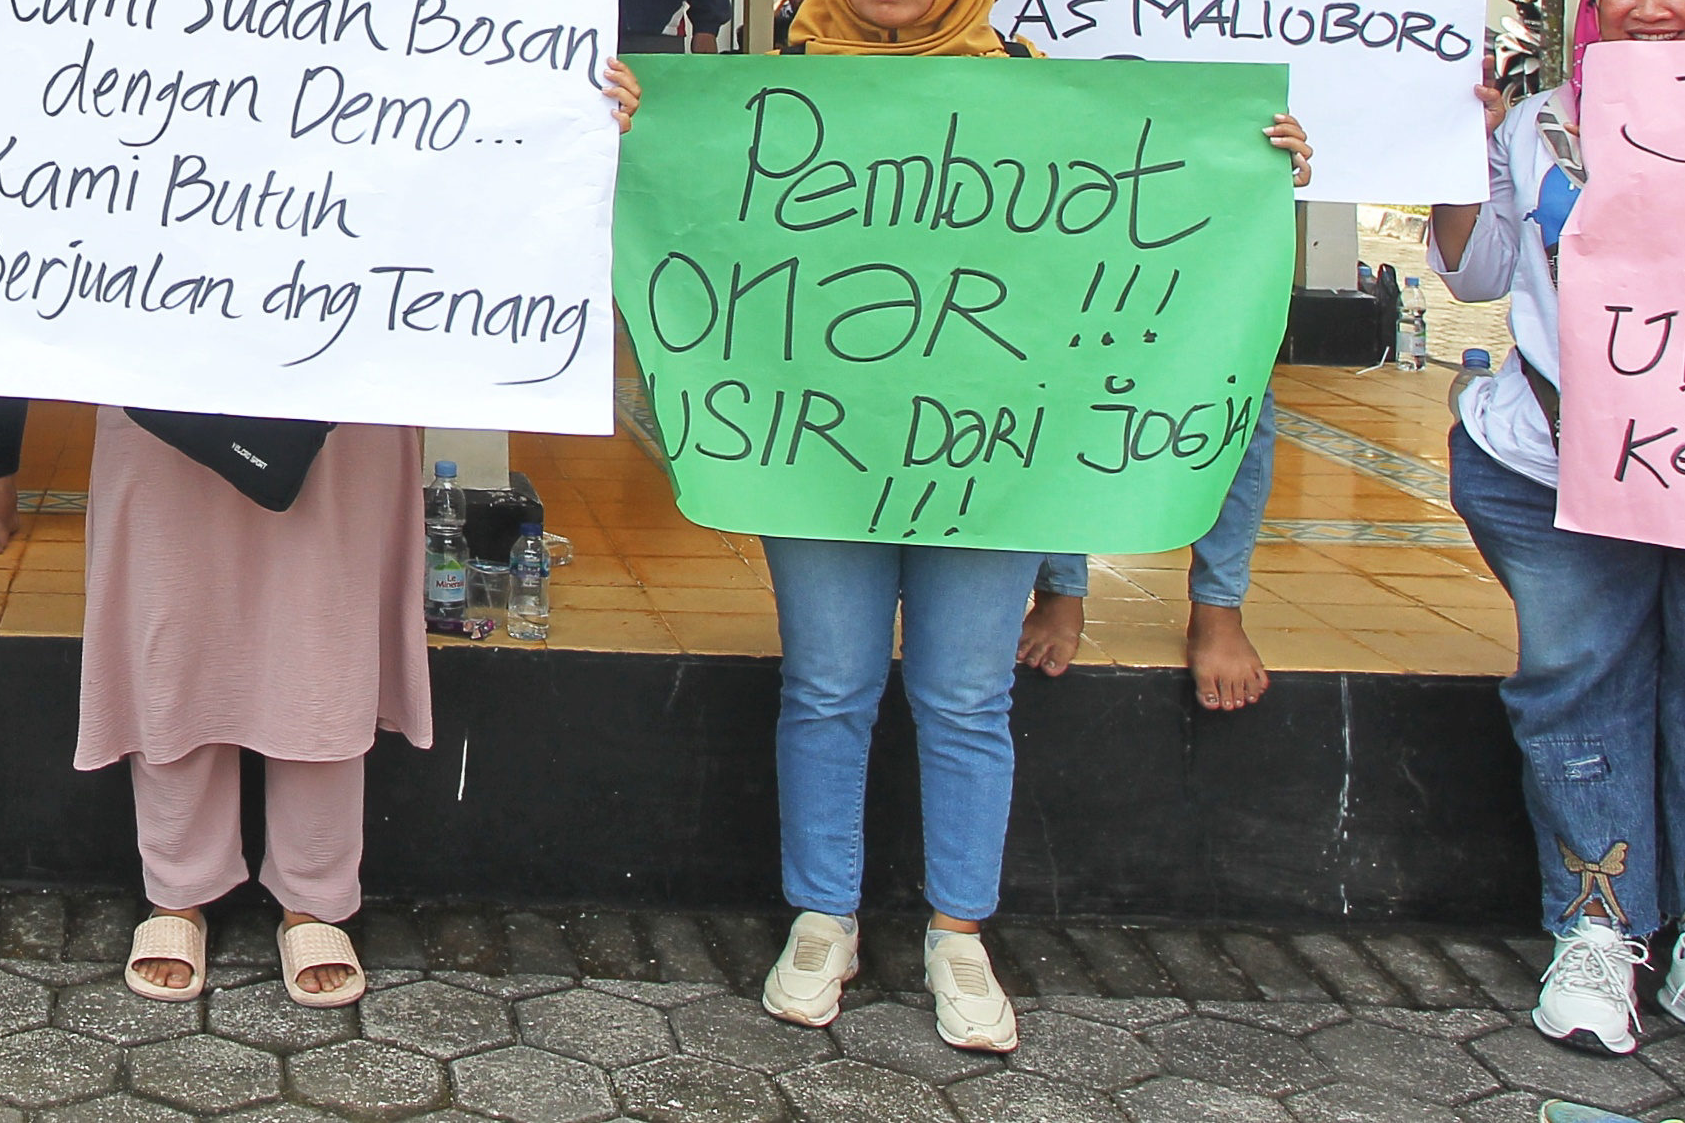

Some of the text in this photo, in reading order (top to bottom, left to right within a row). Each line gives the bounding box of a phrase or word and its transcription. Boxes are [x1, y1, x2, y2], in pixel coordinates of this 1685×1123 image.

[42, 40, 524, 152] dengan Demo...
[161, 154, 360, 238] Butuh
[738, 87, 1212, 249] Pembuat
[263, 260, 362, 367] dng
[370, 266, 589, 386] Tenang
